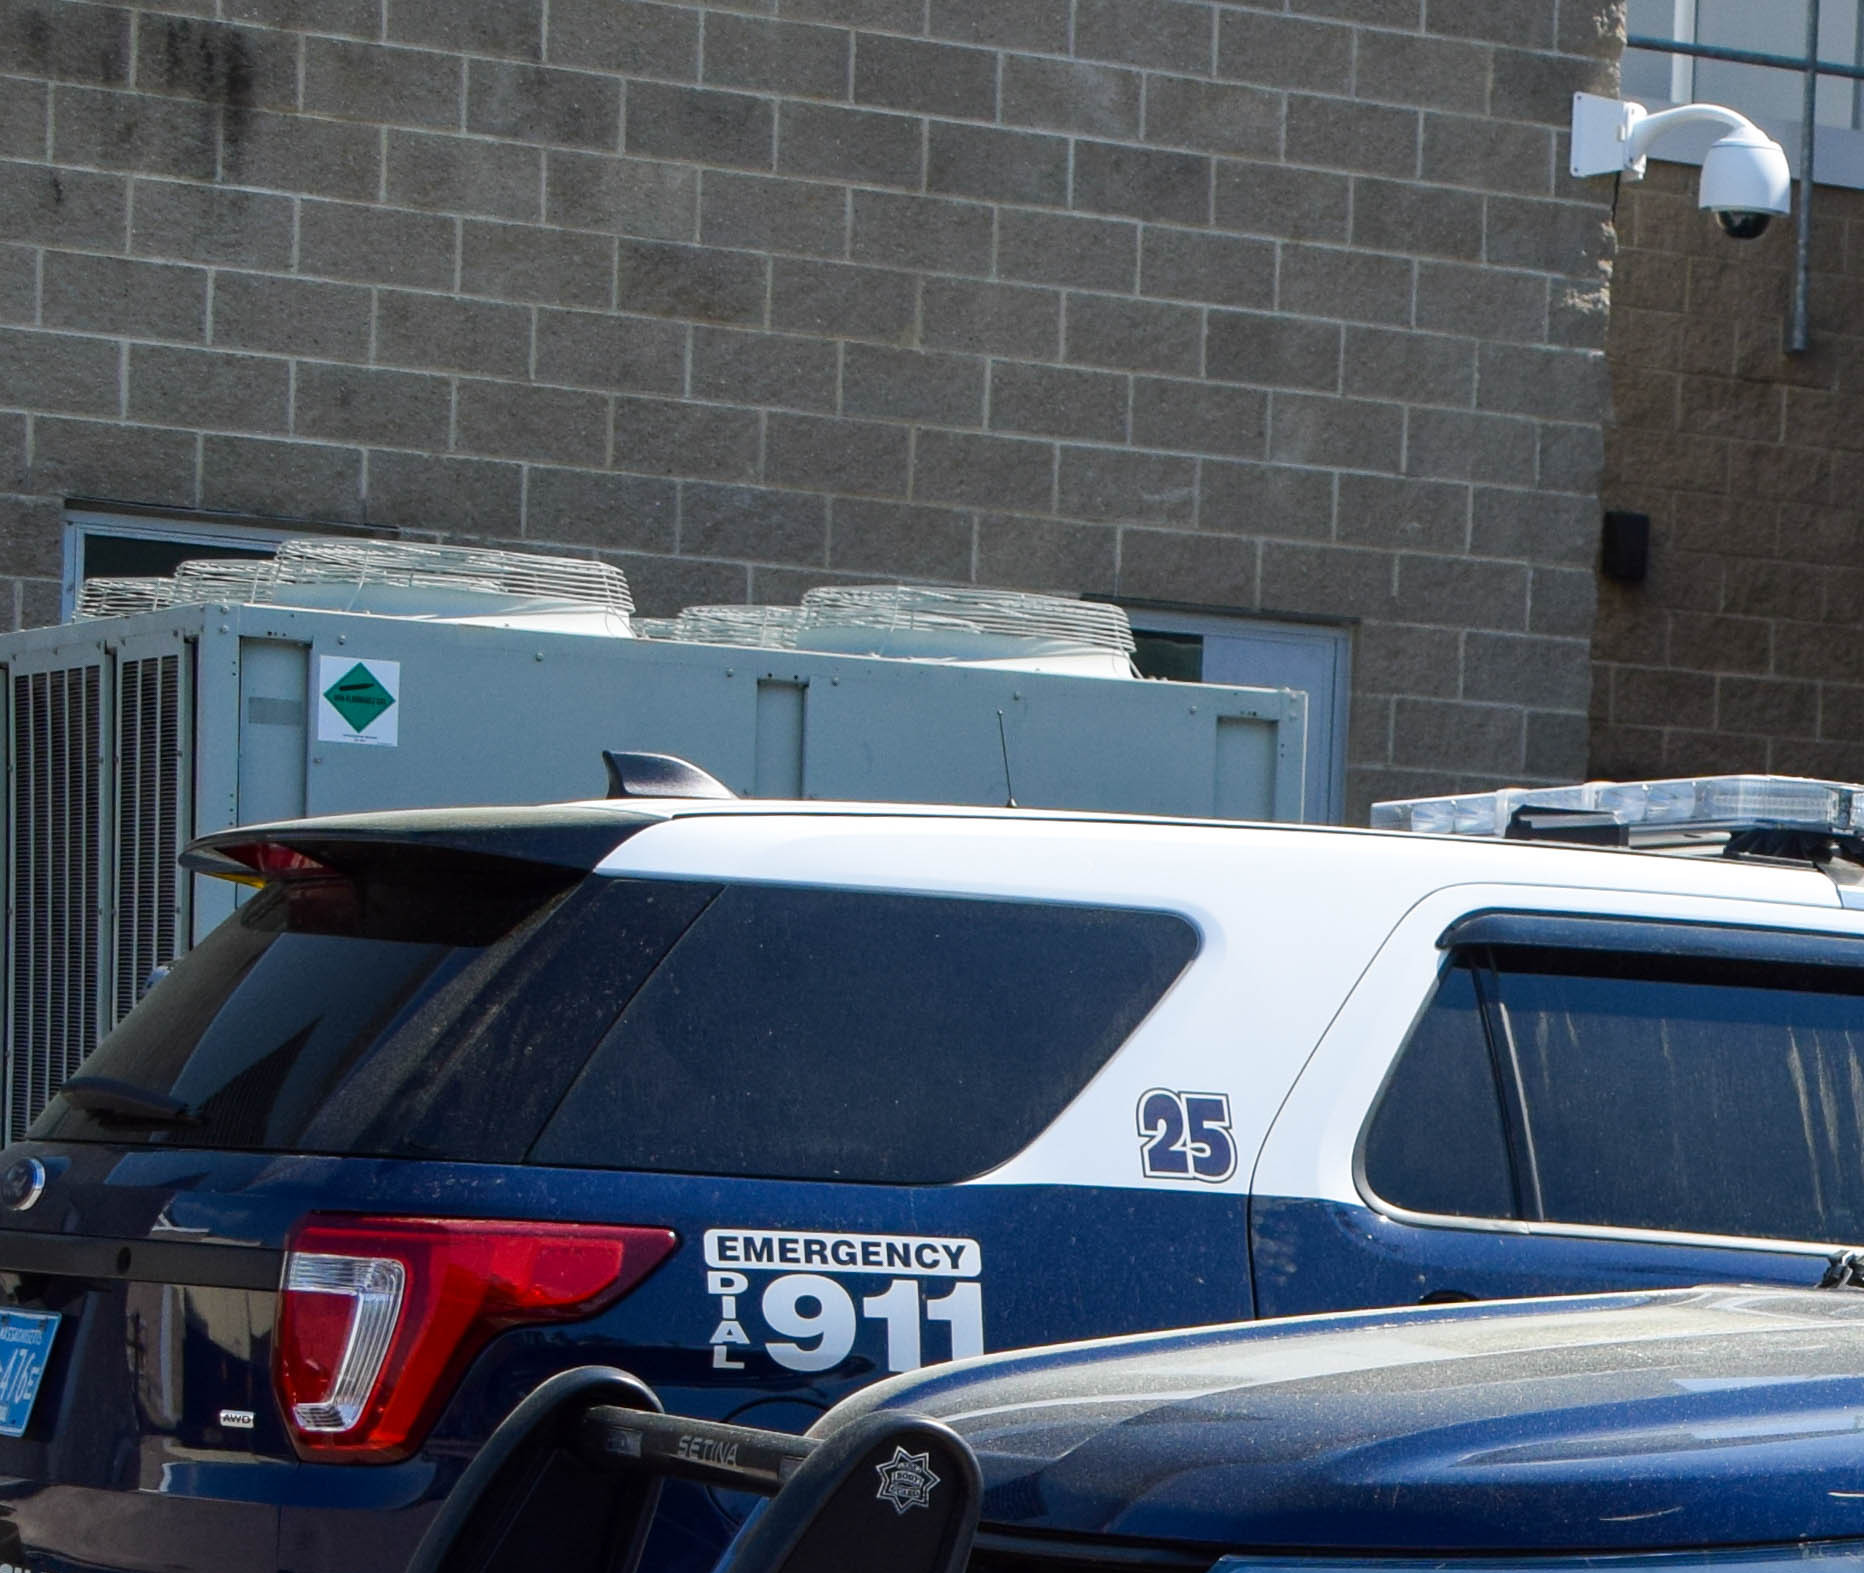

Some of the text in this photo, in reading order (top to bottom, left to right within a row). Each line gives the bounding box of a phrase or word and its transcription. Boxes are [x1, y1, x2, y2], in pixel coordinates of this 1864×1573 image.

[1136, 1087, 1238, 1184] 25
[717, 1235, 966, 1270] EMERGENCY
[706, 1271, 750, 1369] DIAL
[762, 1273, 985, 1373] 911
[677, 1434, 739, 1467] SETINA
